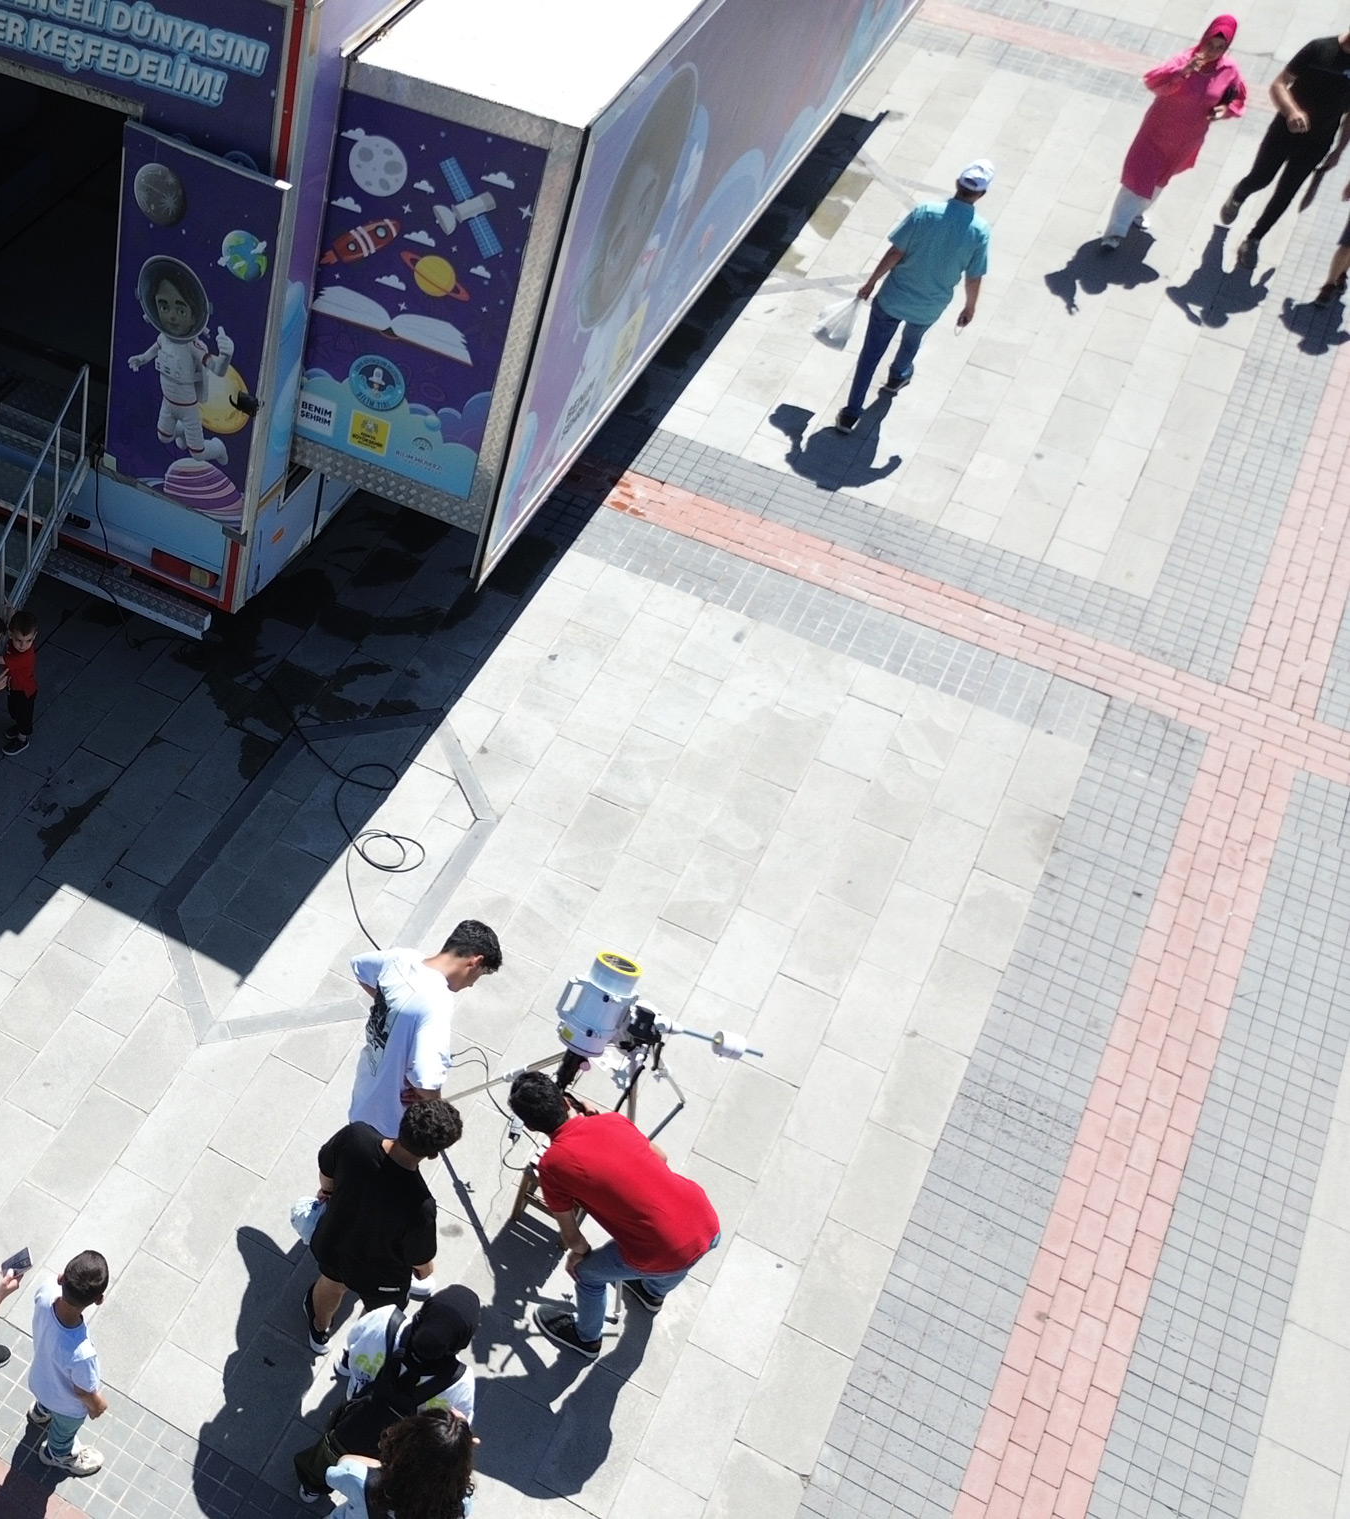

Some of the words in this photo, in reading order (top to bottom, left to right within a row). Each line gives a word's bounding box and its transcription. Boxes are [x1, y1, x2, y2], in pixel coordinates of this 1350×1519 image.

[110, 5, 267, 71] DÜNYASINI
[30, 21, 226, 102] KEŞFEDELİM!
[300, 409, 331, 427] ŞEHRİM
[301, 401, 333, 419] BENİM
